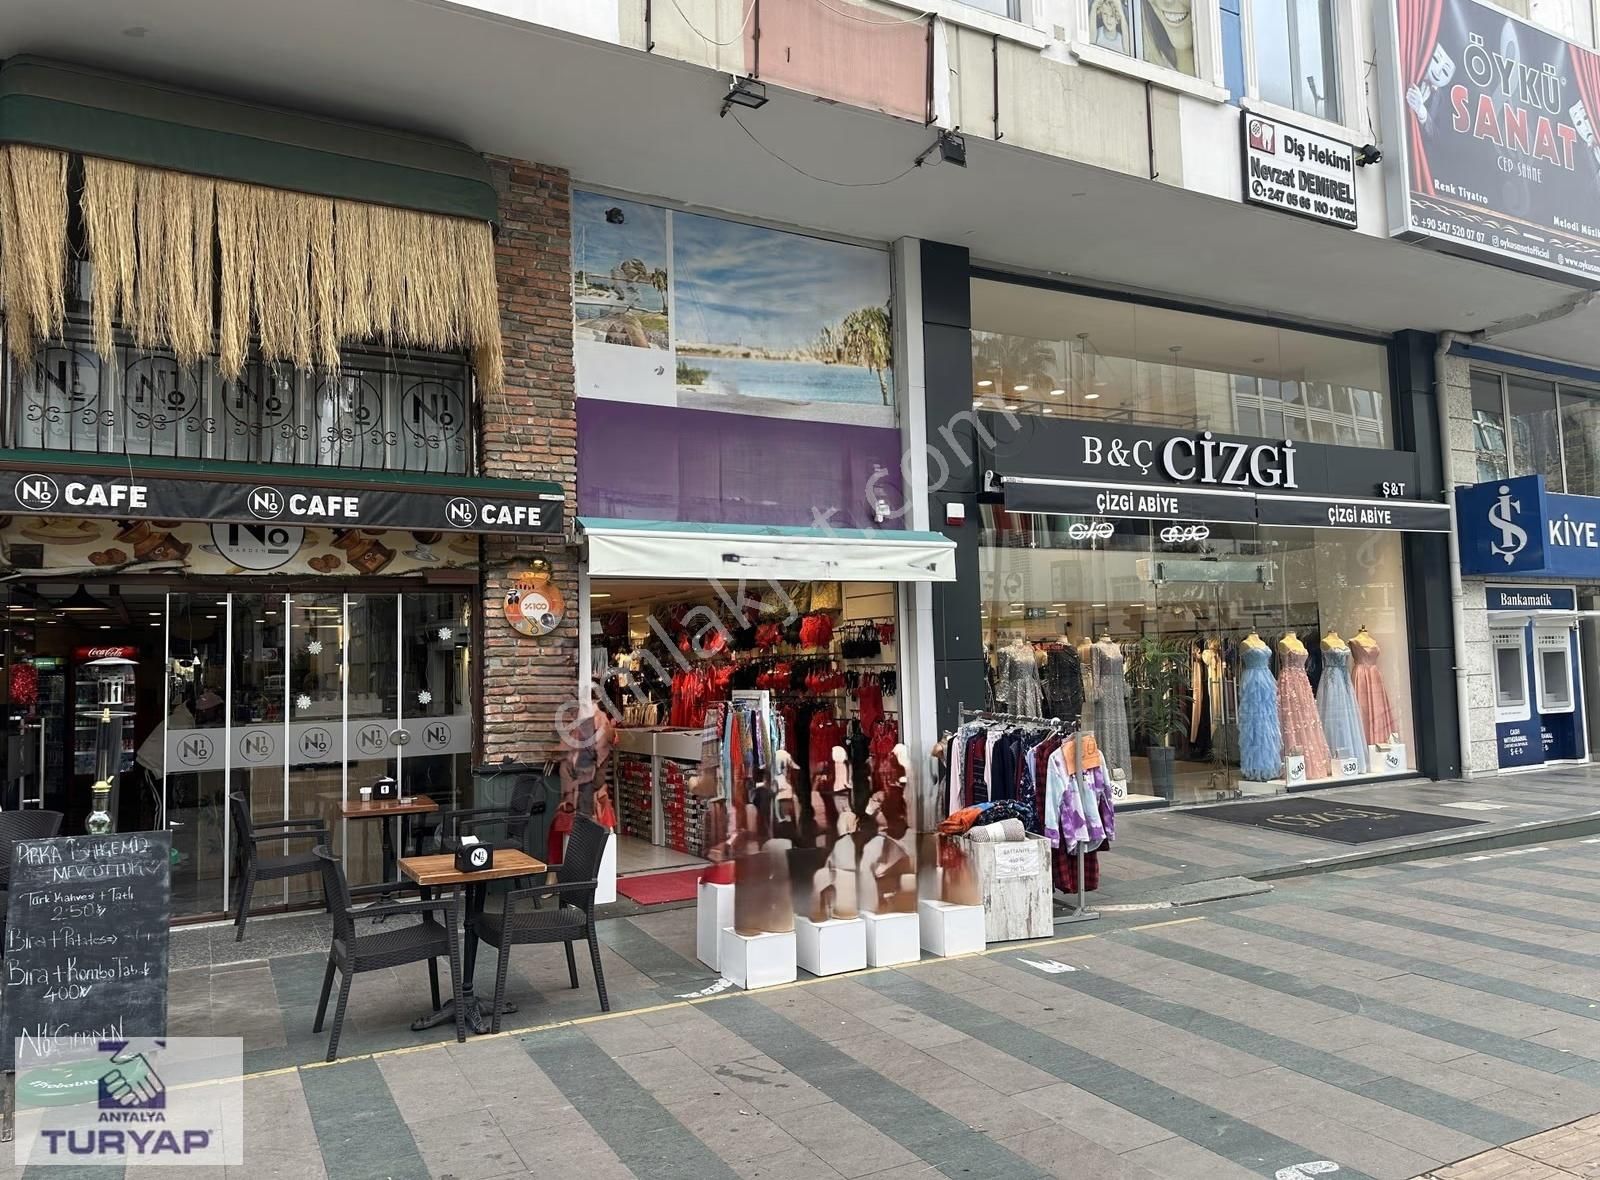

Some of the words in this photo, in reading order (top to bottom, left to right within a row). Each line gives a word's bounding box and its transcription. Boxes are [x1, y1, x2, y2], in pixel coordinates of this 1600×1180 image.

[1463, 32, 1562, 116] ÖYKÜ
[1450, 84, 1577, 172] SANAT
[1284, 135, 1305, 162] Diş
[1308, 142, 1351, 172] Hekimi
[1250, 155, 1296, 189] Nevzat
[1434, 179, 1456, 195] Renk
[1458, 187, 1489, 205] Tiyatro
[1421, 217, 1437, 230] +90
[1437, 220, 1451, 233] 547
[1451, 223, 1465, 237] 520
[1466, 230, 1475, 241] 07
[1476, 233, 1485, 243] 07
[1553, 215, 1579, 232] Melodi
[1081, 435, 1154, 476] B&Ç
[64, 482, 148, 509] CAFE
[289, 493, 360, 518] CAFE
[1096, 490, 1134, 514] ÇİZGİ
[1137, 493, 1179, 514] ABİYE
[481, 504, 542, 526] CAFE
[1327, 506, 1359, 525] ÇİZGİ
[1361, 508, 1392, 526] ABİYE
[1500, 592, 1552, 608] Bankamatik
